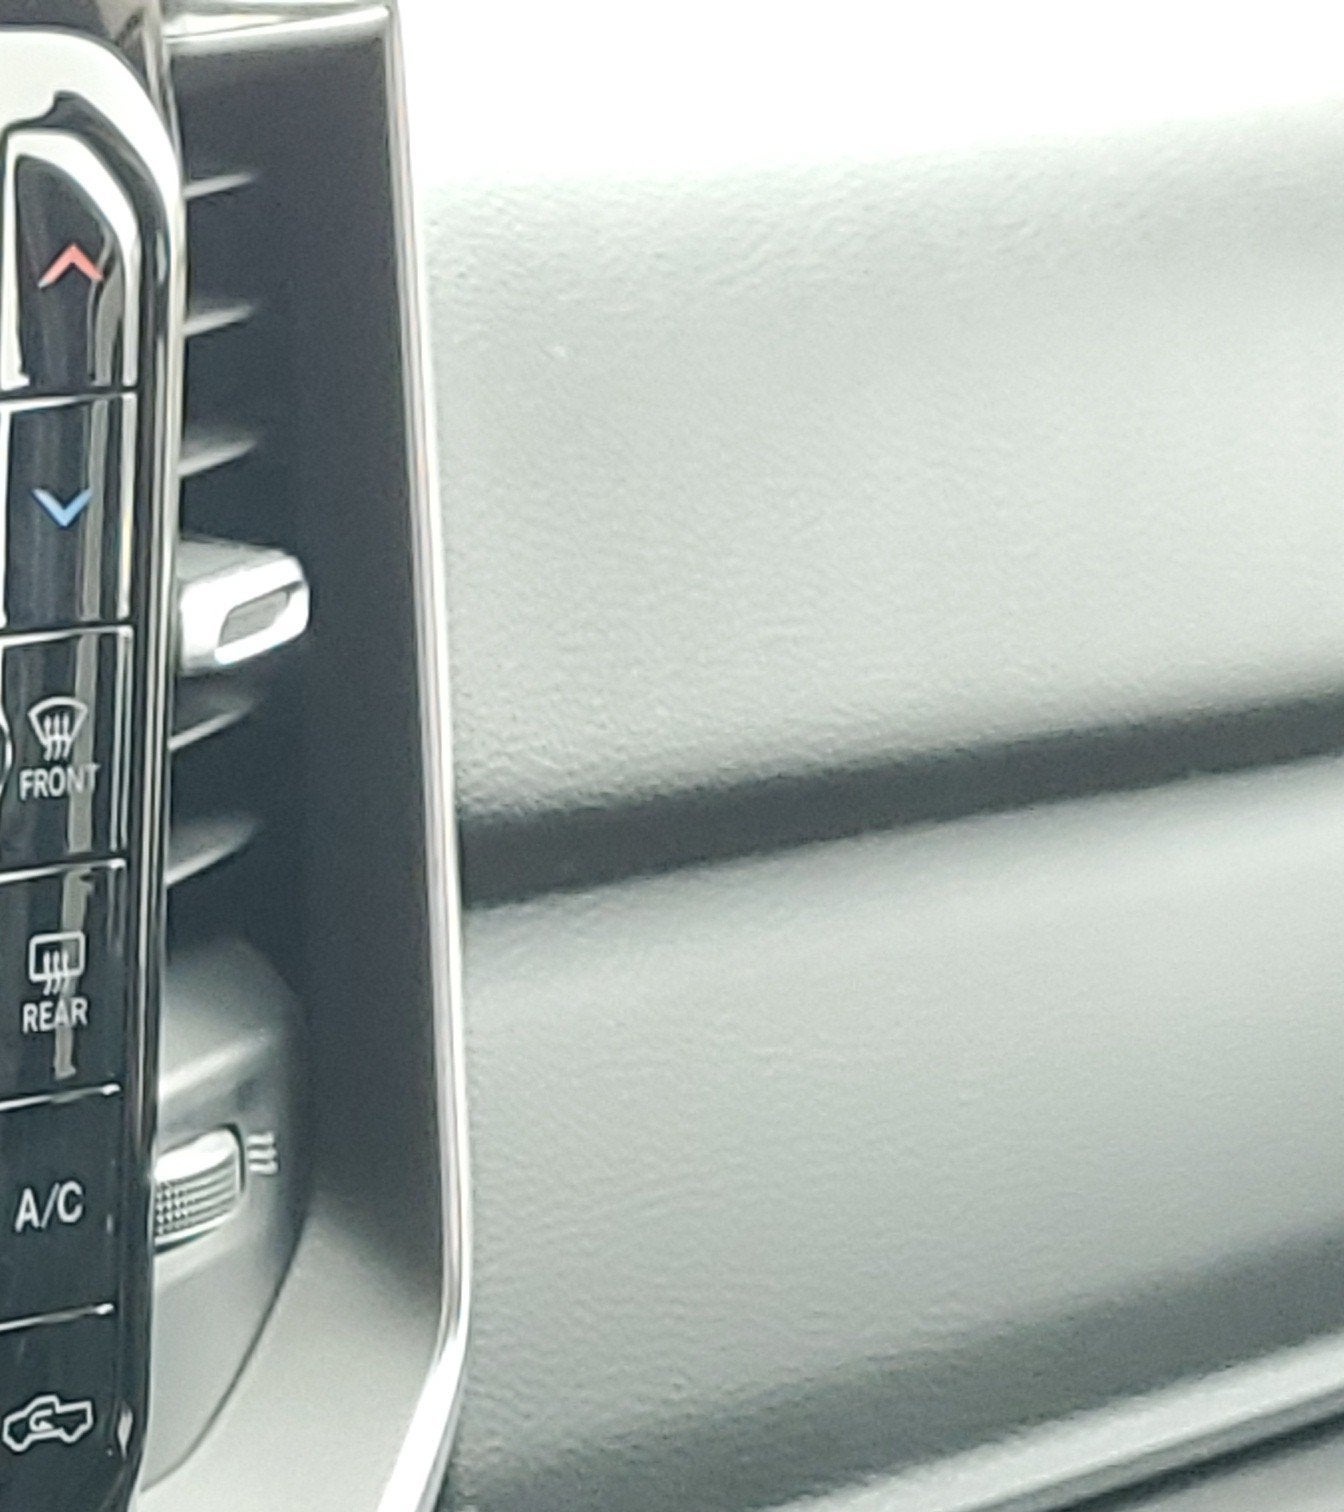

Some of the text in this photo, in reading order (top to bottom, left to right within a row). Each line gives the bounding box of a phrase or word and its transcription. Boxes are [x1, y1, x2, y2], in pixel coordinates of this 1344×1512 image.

[18, 763, 100, 801] FRONT
[22, 997, 89, 1034] REAR
[14, 1180, 85, 1234] A/C
